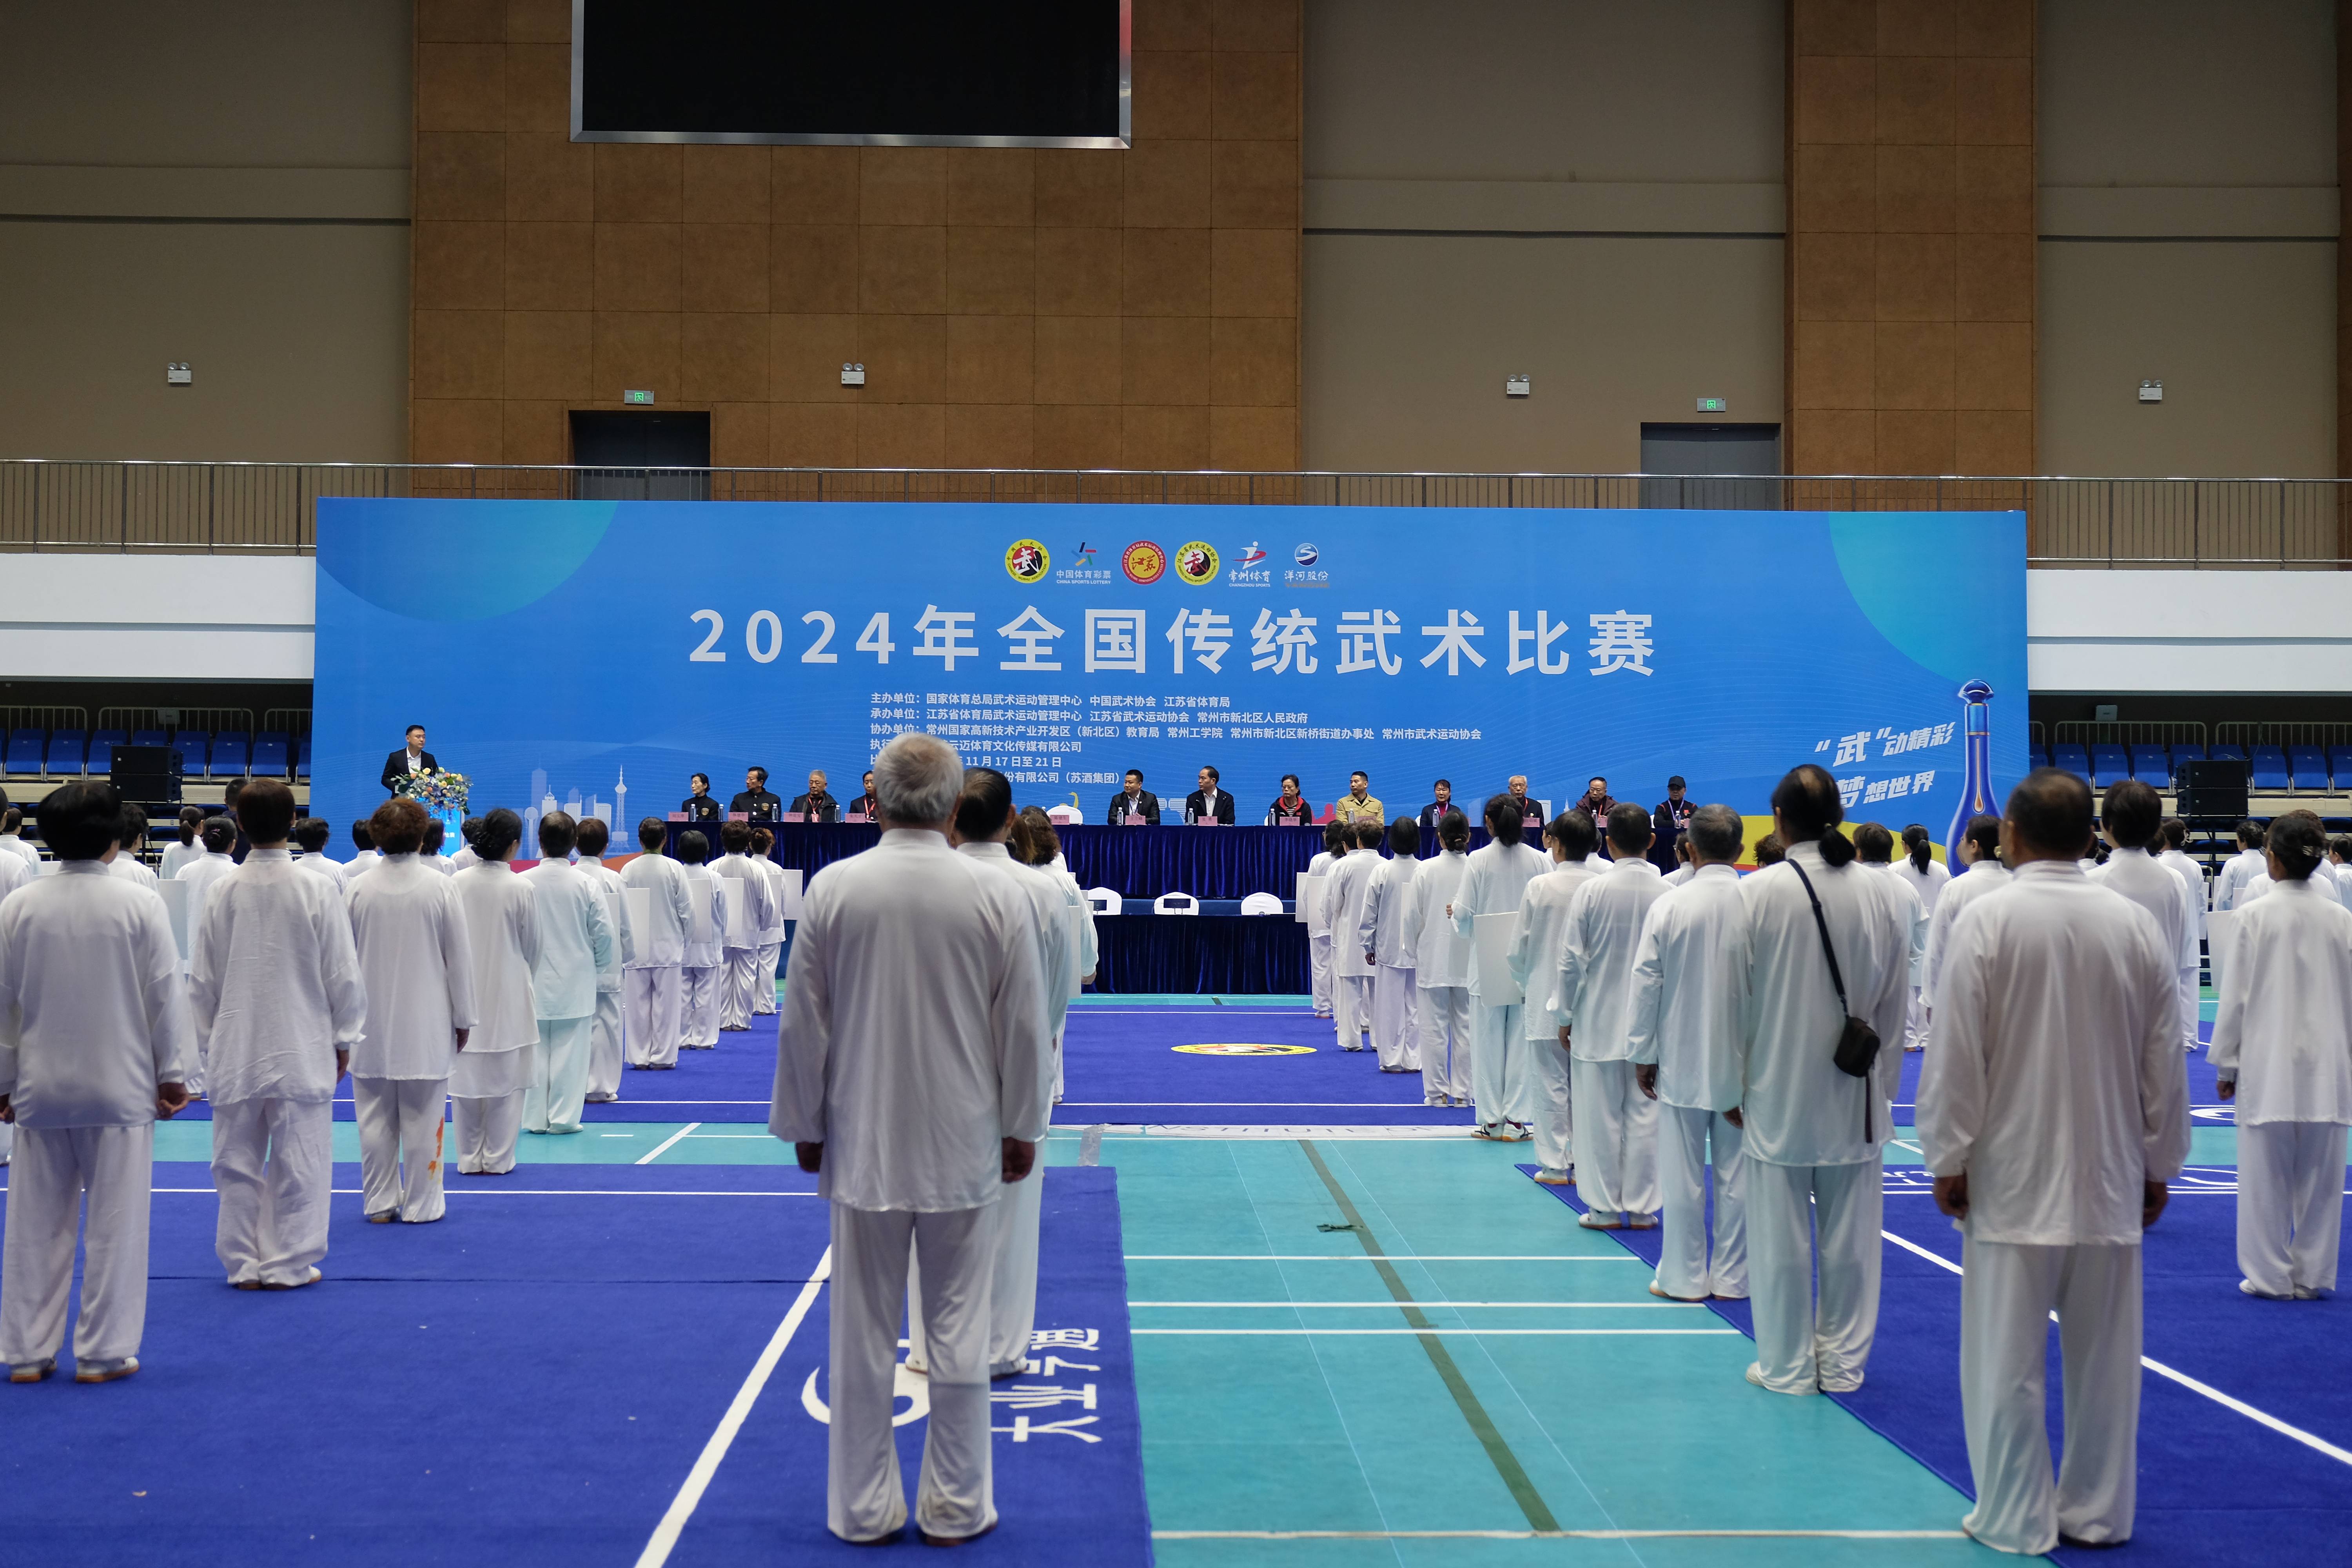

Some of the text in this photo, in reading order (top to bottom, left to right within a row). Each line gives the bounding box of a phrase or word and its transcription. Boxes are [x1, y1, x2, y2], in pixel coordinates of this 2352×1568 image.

[1056, 570, 1111, 579] 中国体育彩票
[1229, 569, 1270, 583] 常州体育
[1285, 570, 1328, 582] 洋河股份
[689, 604, 1655, 676] 2024年全国传统武术比赛
[1090, 695, 1156, 707] 中国武术协会
[1164, 696, 1230, 708] 江苏省体育局
[1089, 711, 1190, 723] 江苏省武术运动协会
[1197, 712, 1308, 724] 常州市新北区人民政府
[1167, 727, 1223, 739] 常州工学院
[1230, 727, 1374, 740] 常州市新北区新桥街道办事处
[1382, 728, 1482, 740] 常州市武术运动协会
[944, 740, 1082, 753] 云迈体育文化传媒有限公司
[1000, 771, 1119, 784] 份有限公司（苏酒集团）
